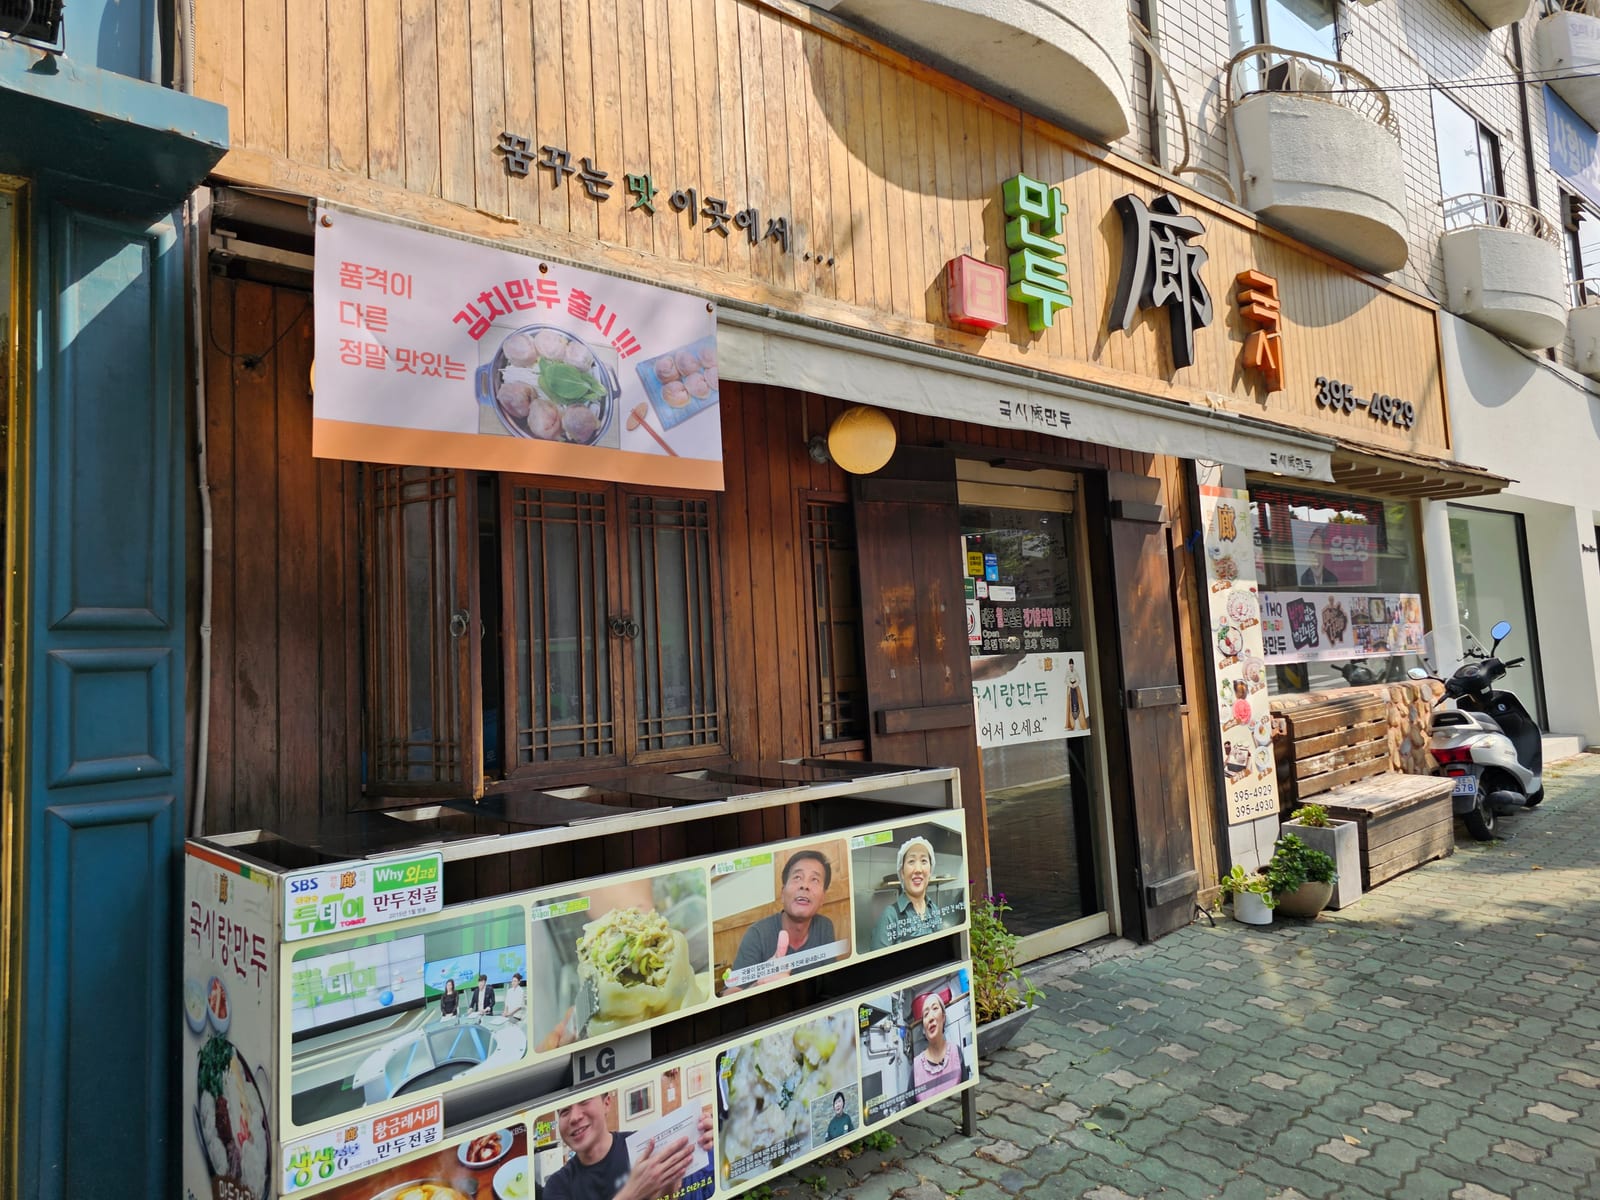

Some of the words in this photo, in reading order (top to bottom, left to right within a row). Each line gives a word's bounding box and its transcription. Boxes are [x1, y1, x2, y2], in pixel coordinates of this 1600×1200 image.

[498, 131, 614, 200] 꿈꾸는
[624, 173, 659, 214] 맛
[1002, 172, 1073, 331] 만두
[338, 261, 413, 299] 품격이
[1108, 192, 1214, 370] 廊
[338, 301, 389, 332] 다른
[452, 278, 561, 341] 김치만두
[567, 287, 617, 337] 출시
[1235, 268, 1286, 392] 국시
[338, 337, 387, 371] 정말
[395, 347, 467, 381] 맛있는
[1314, 376, 1416, 430] 395-4929
[981, 722, 1005, 740] 어서
[1233, 784, 1273, 803] 395-4929
[1235, 799, 1275, 818] 395-4930
[290, 877, 318, 893] SBS
[375, 869, 404, 884] Why
[288, 893, 365, 935] 투데이
[373, 885, 438, 913] 만두전골
[190, 901, 267, 988] 국시랑만두
[579, 1047, 616, 1080] LG
[374, 1104, 439, 1140] 황금레시피
[377, 1127, 437, 1159] 만두전골
